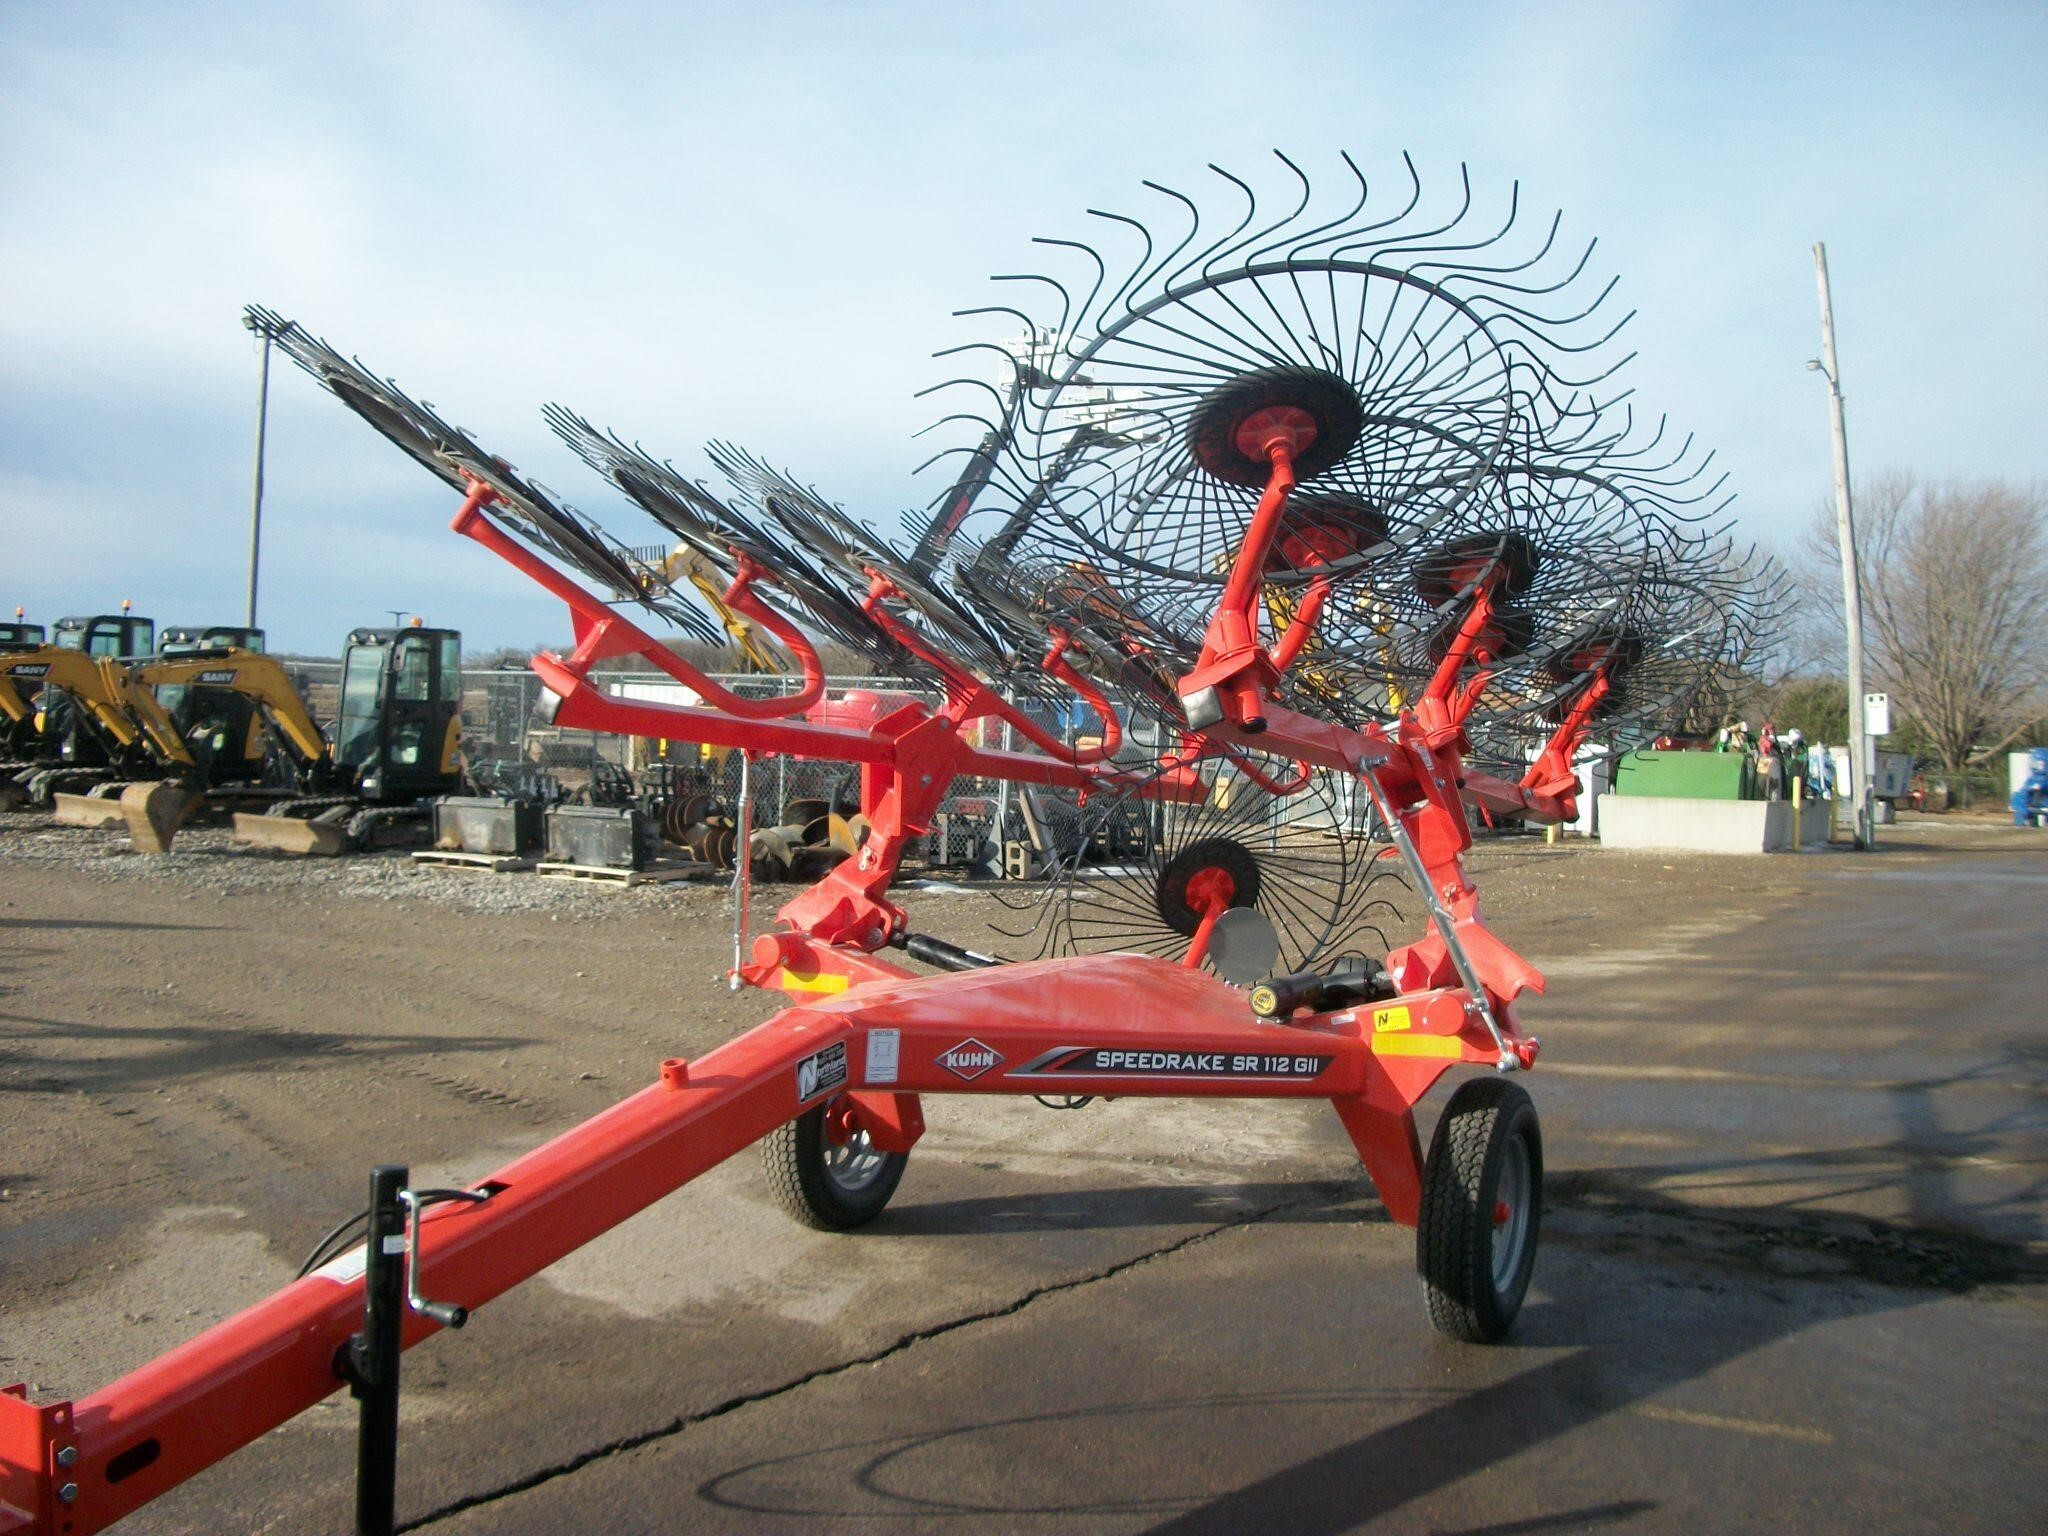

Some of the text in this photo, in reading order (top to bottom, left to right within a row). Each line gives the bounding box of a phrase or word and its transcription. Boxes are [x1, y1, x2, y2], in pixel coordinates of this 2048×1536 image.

[202, 671, 234, 682] SANY
[947, 1052, 994, 1067] KUHN
[1095, 1051, 1225, 1071] SPEEDRAKE
[1232, 1055, 1259, 1072] SR
[1263, 1057, 1289, 1073] 112
